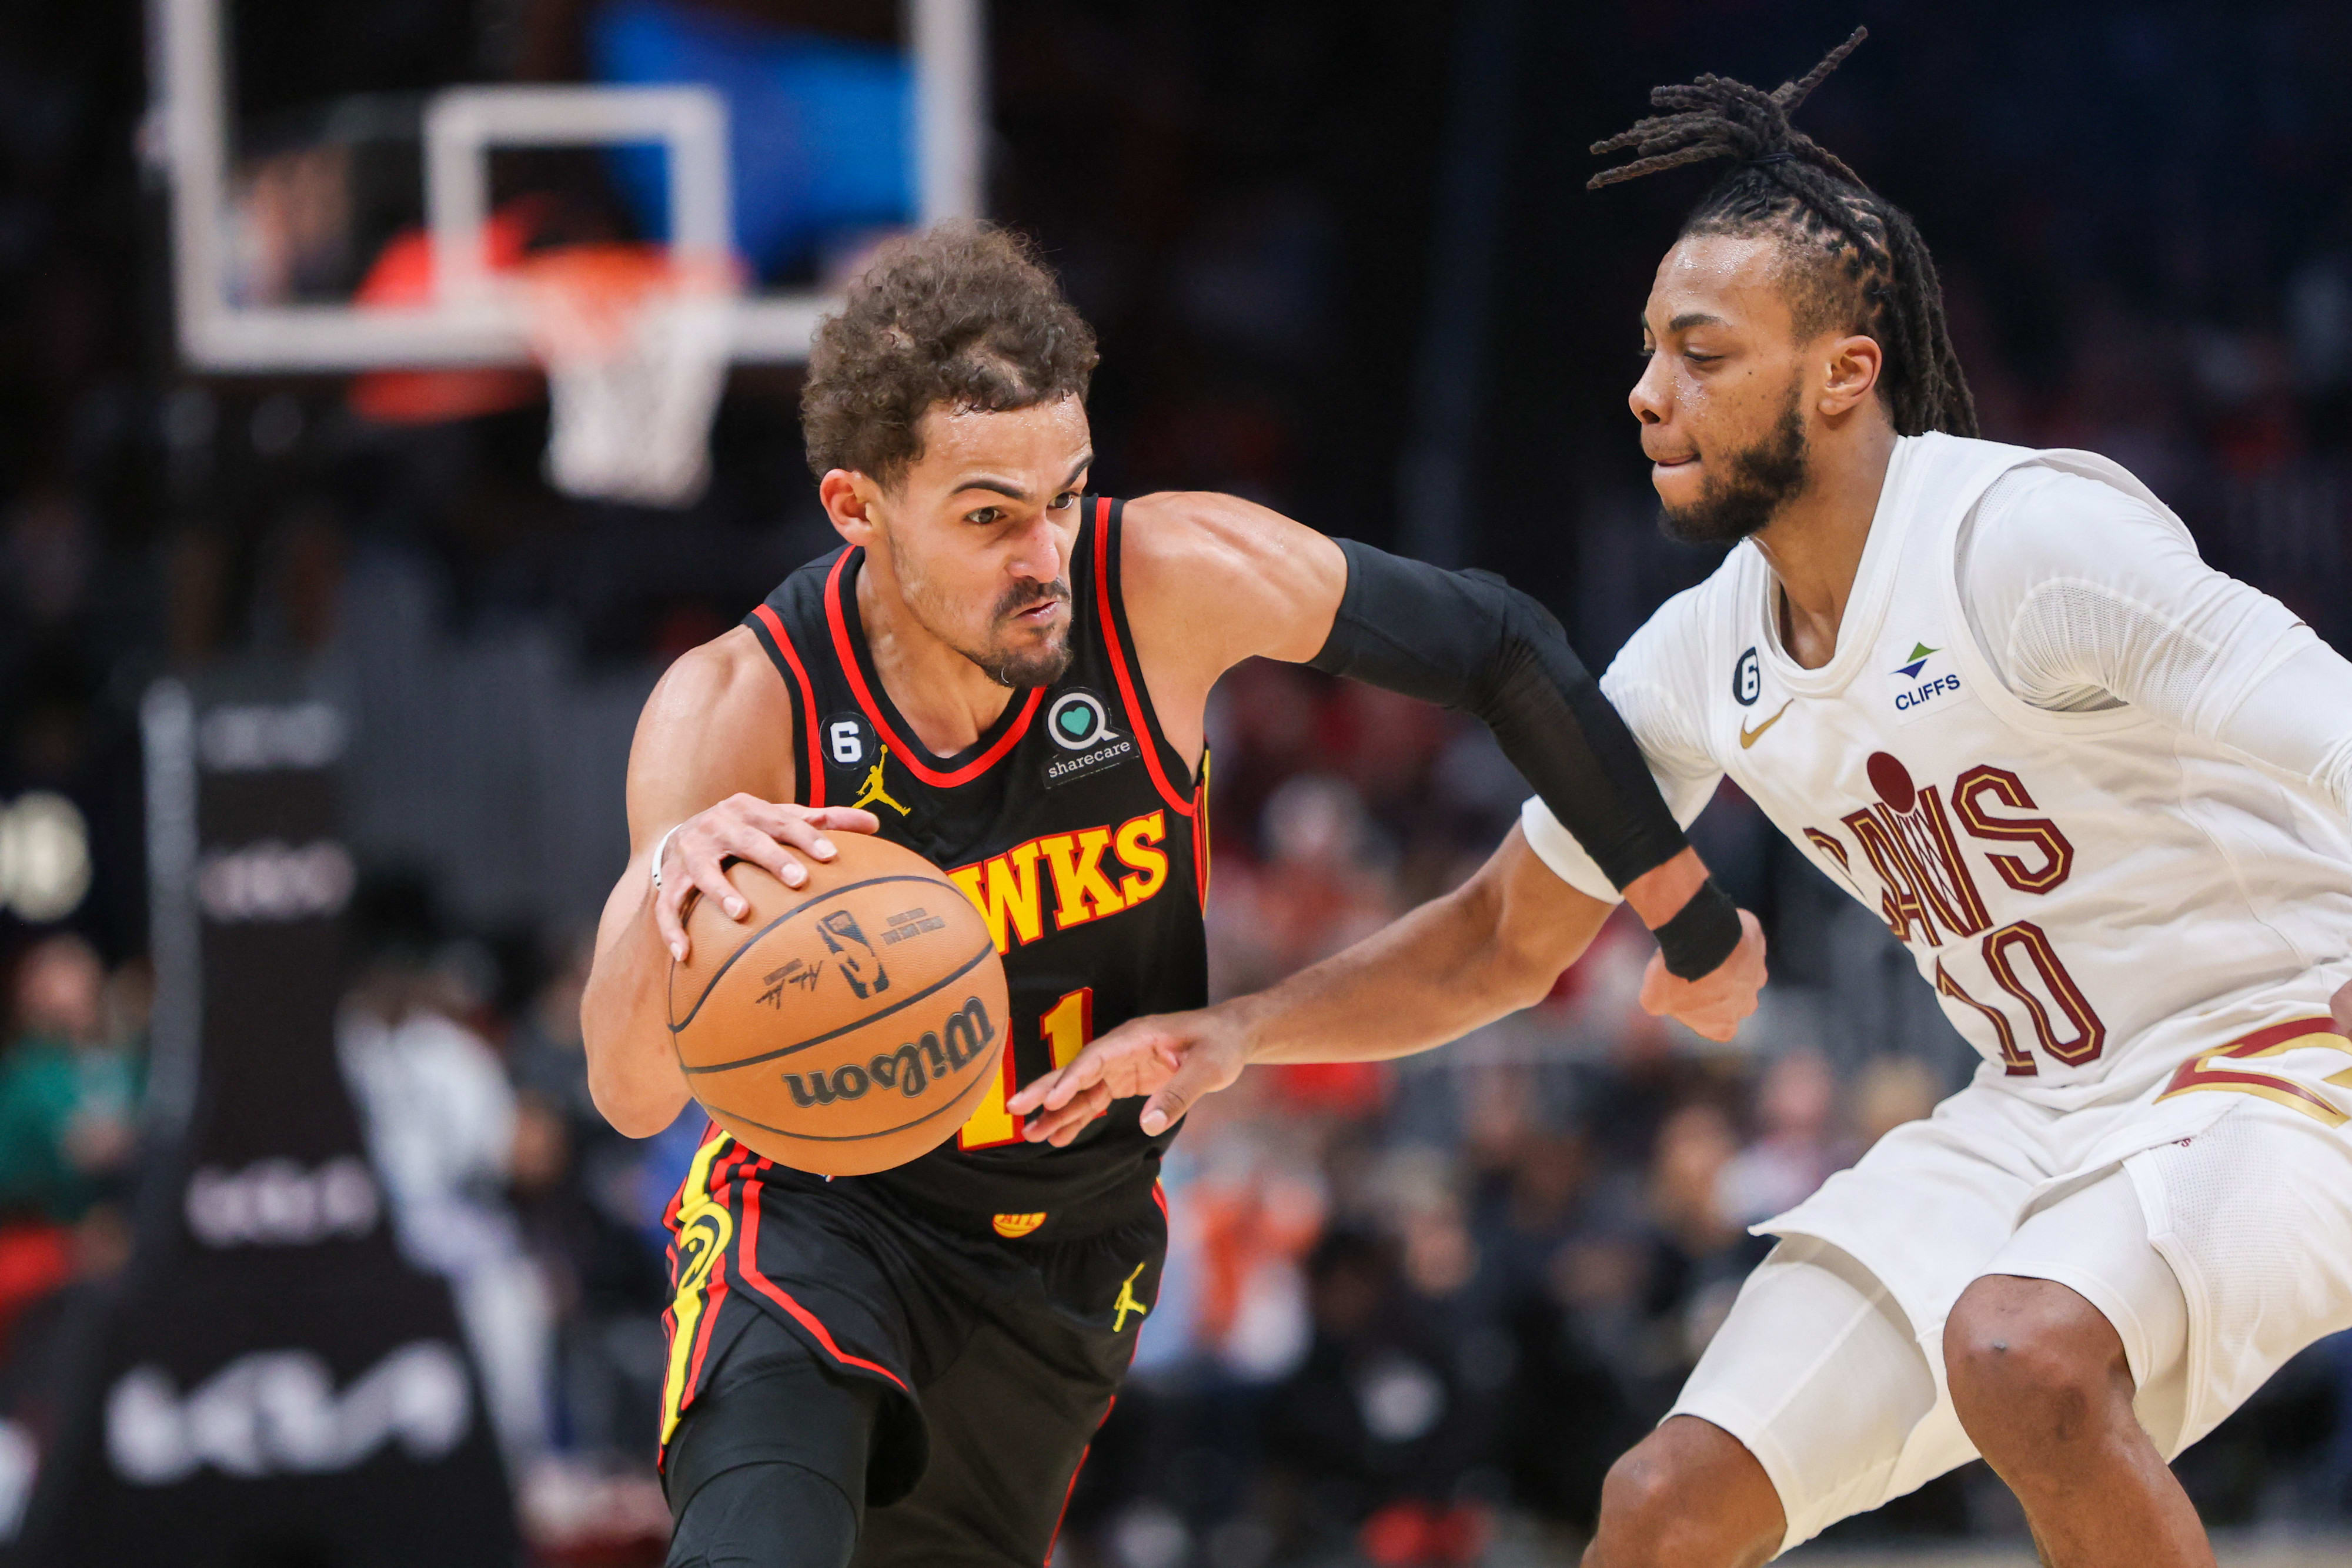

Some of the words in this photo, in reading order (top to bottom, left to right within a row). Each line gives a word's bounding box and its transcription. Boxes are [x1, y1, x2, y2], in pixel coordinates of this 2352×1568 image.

[1741, 654, 1759, 701] 6
[1895, 674, 1960, 711] CLIFFS
[829, 720, 863, 763] 6
[1048, 741, 1131, 778] sharecare
[944, 808, 1169, 957] WKS
[1936, 920, 2107, 1078] 10
[780, 995, 995, 1108] Wilson
